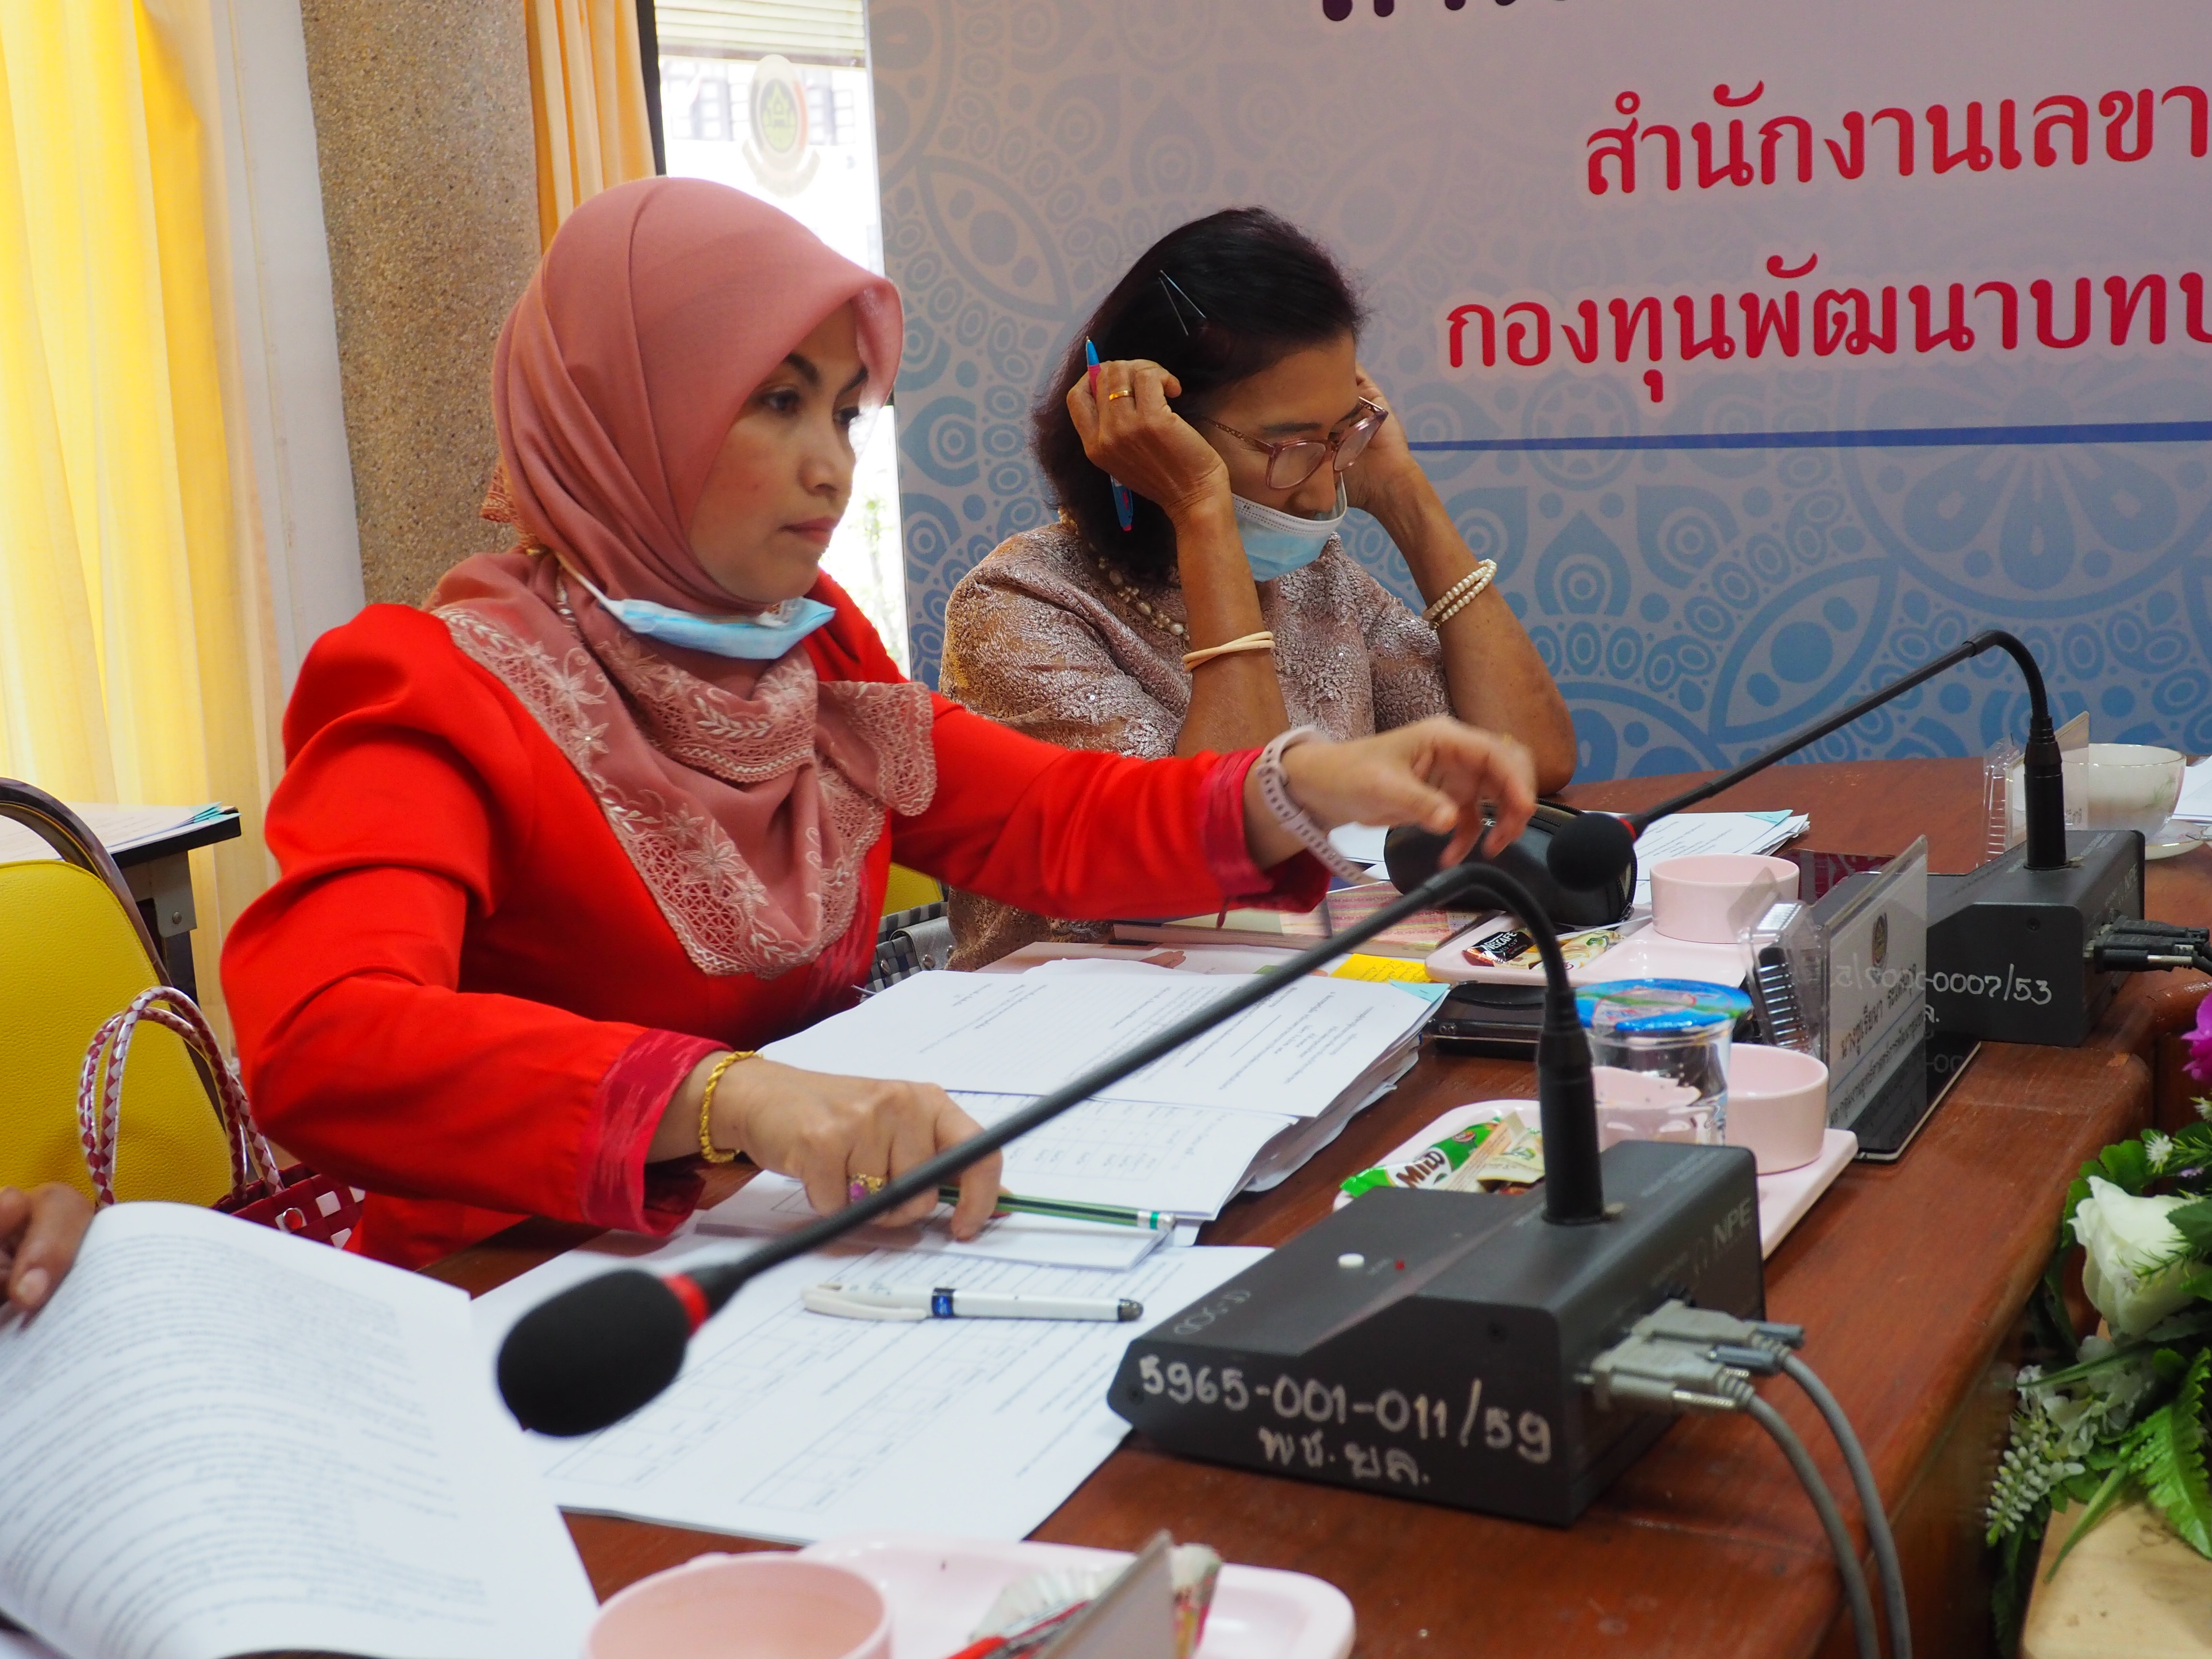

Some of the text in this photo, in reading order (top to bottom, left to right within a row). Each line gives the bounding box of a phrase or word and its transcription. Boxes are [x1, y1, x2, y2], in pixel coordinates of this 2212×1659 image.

[1586, 81, 2209, 196] สำนักงานเลขา
